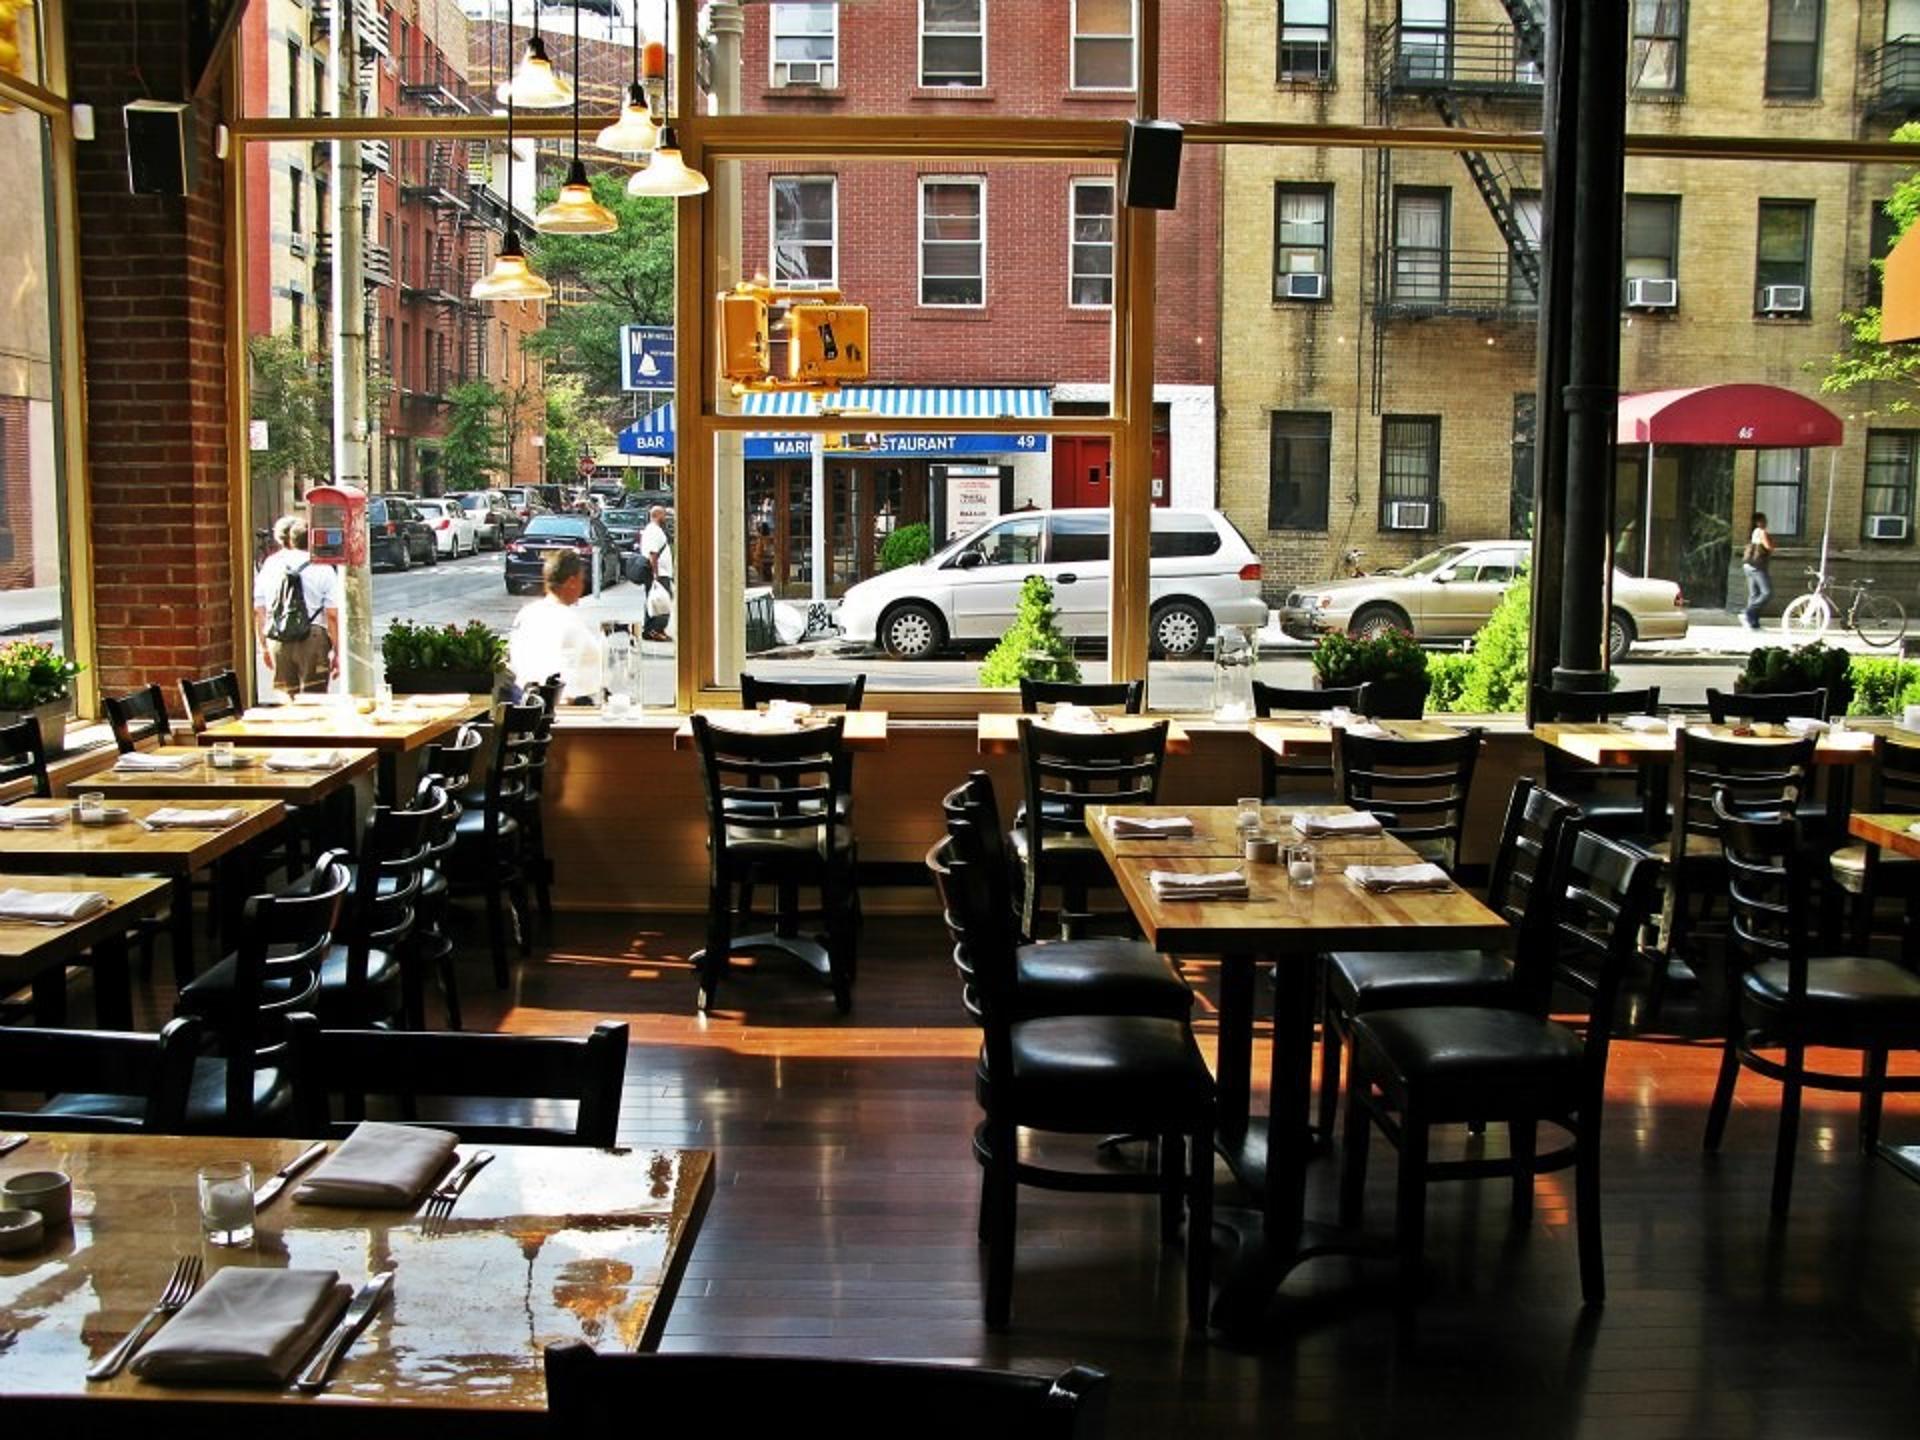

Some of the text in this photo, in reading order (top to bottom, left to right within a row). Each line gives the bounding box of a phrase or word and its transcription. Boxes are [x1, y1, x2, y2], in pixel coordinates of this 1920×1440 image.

[637, 436, 665, 449] BAR
[879, 436, 957, 451] STAURANT
[1016, 435, 1035, 449] 49
